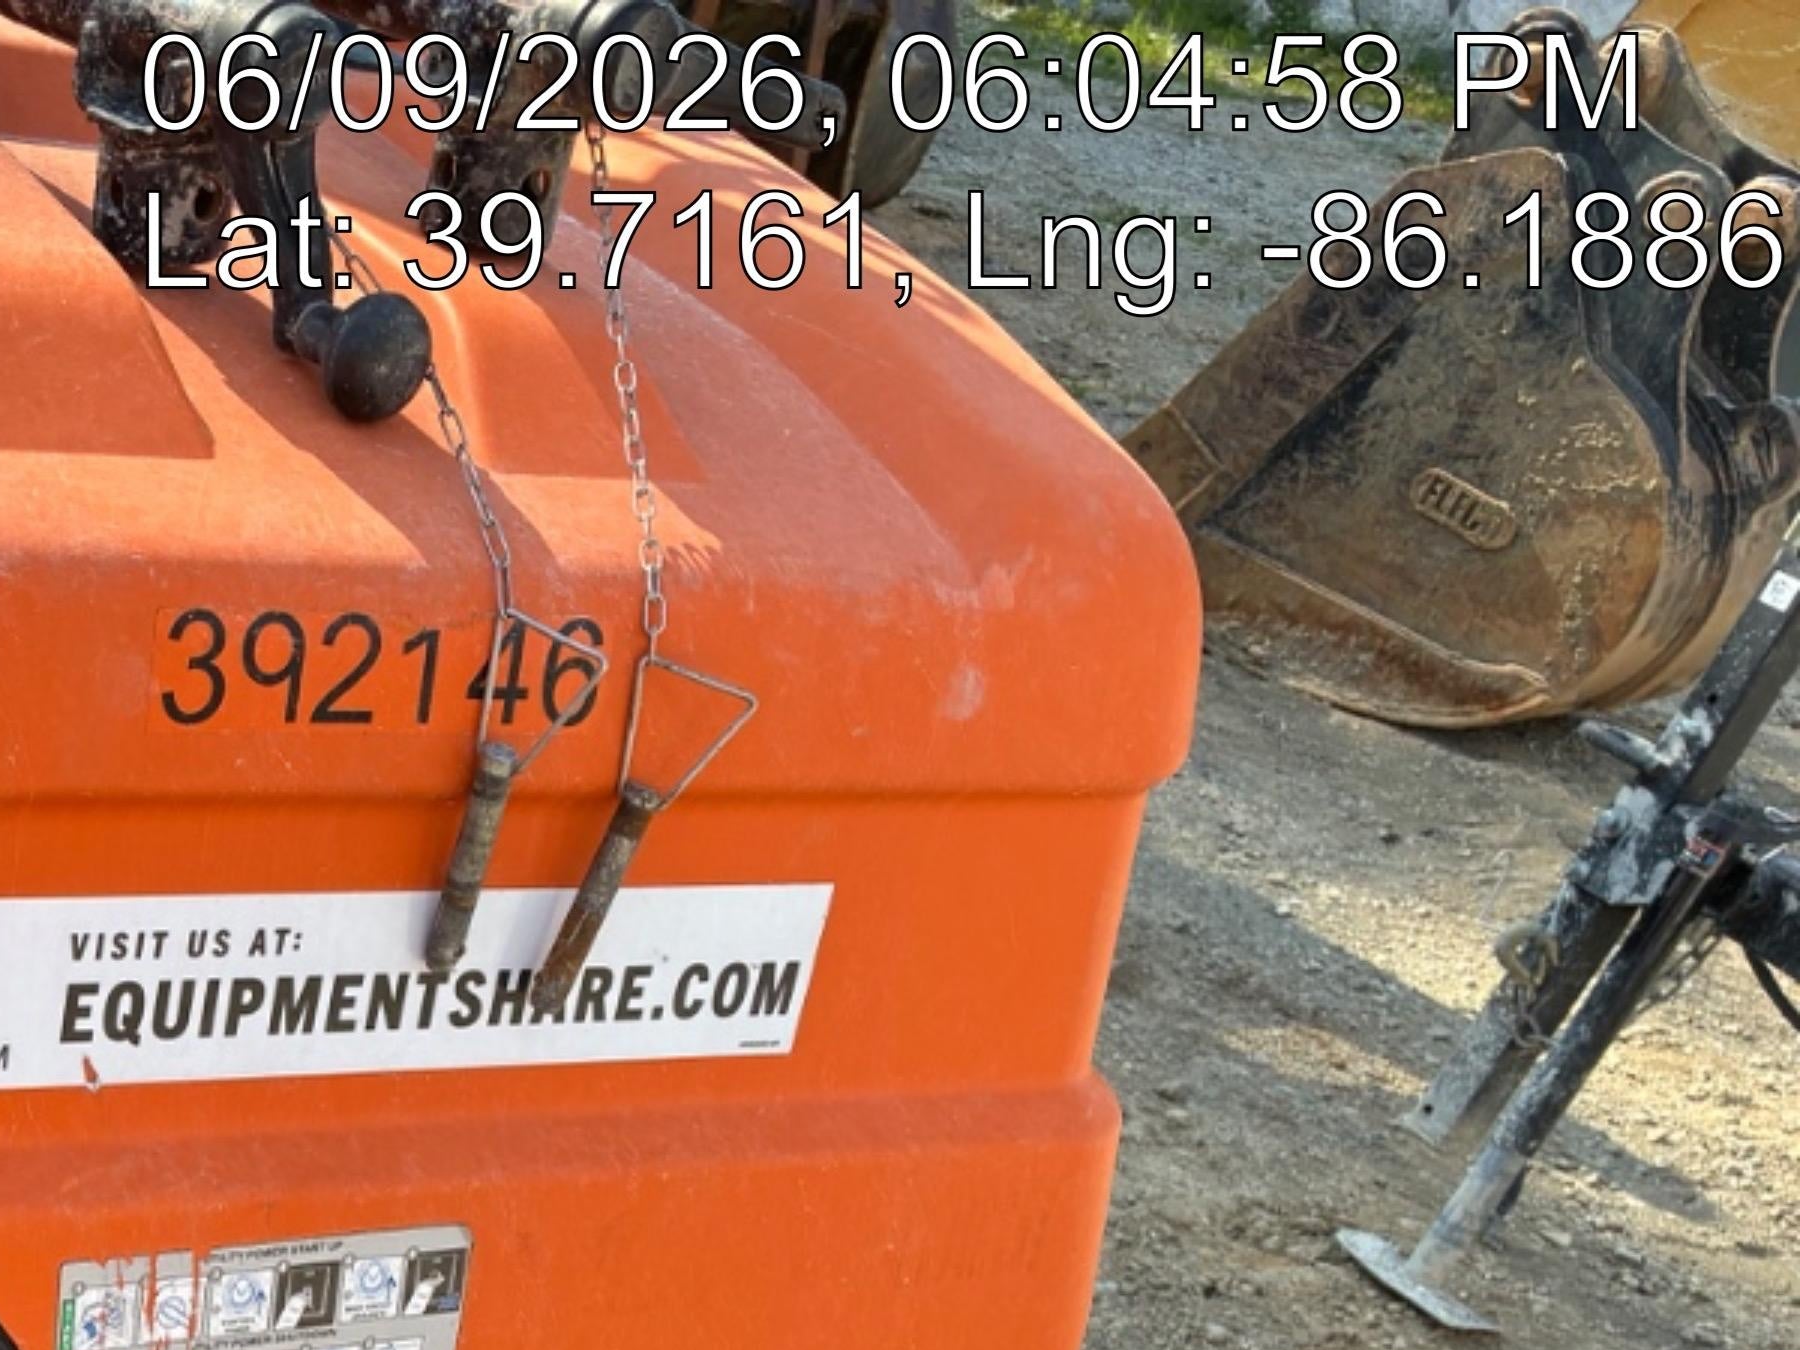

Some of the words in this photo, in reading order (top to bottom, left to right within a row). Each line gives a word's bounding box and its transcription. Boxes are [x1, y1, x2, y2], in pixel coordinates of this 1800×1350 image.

[160, 608, 605, 727] 392146
[69, 931, 169, 961] VISIT
[187, 928, 231, 959] US
[248, 926, 304, 957] AT:
